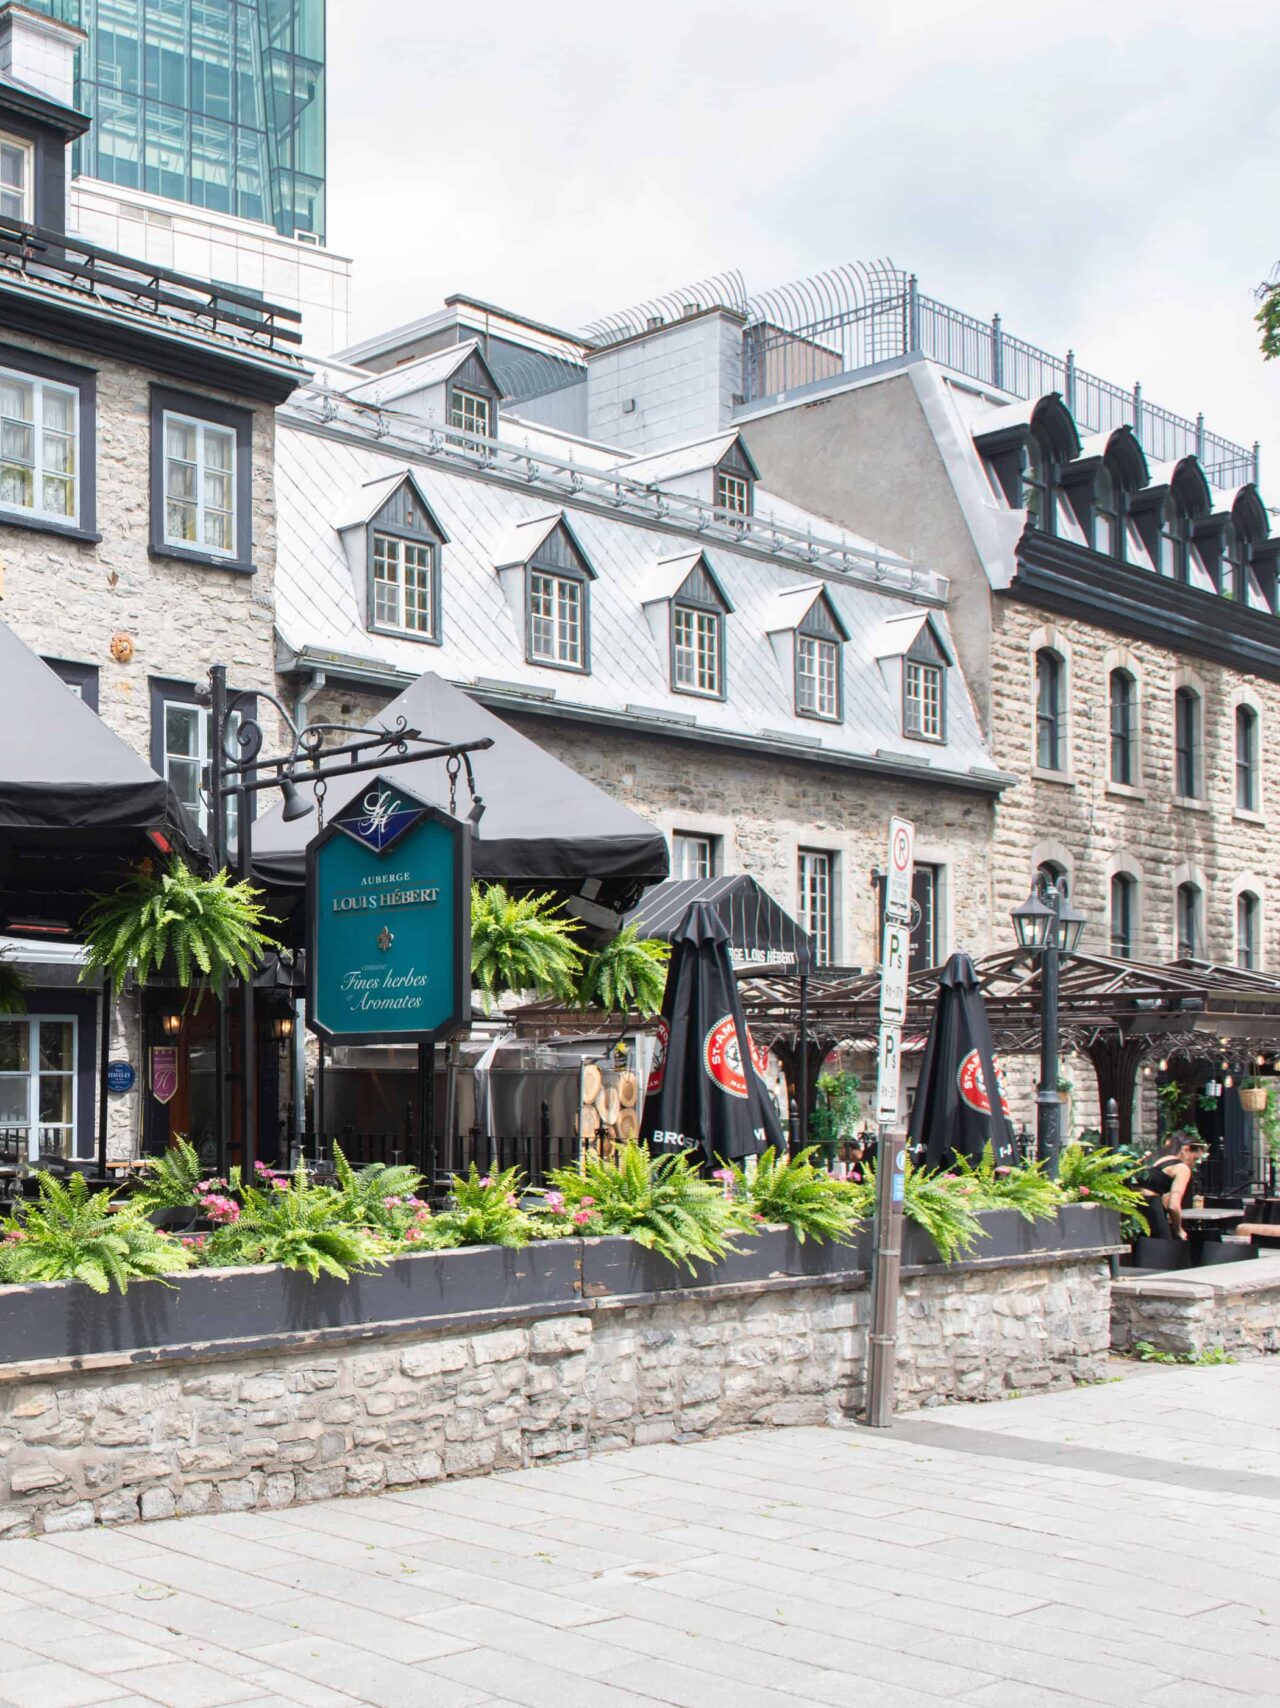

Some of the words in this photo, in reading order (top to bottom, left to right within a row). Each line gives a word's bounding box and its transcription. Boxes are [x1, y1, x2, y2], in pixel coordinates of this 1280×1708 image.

[361, 872, 411, 886] AUBERGE
[332, 895, 378, 912] LOUIS
[380, 888, 440, 907] HÉBERT
[340, 971, 381, 991] Fines
[382, 967, 429, 988] herbes
[350, 991, 423, 1011] Aromates
